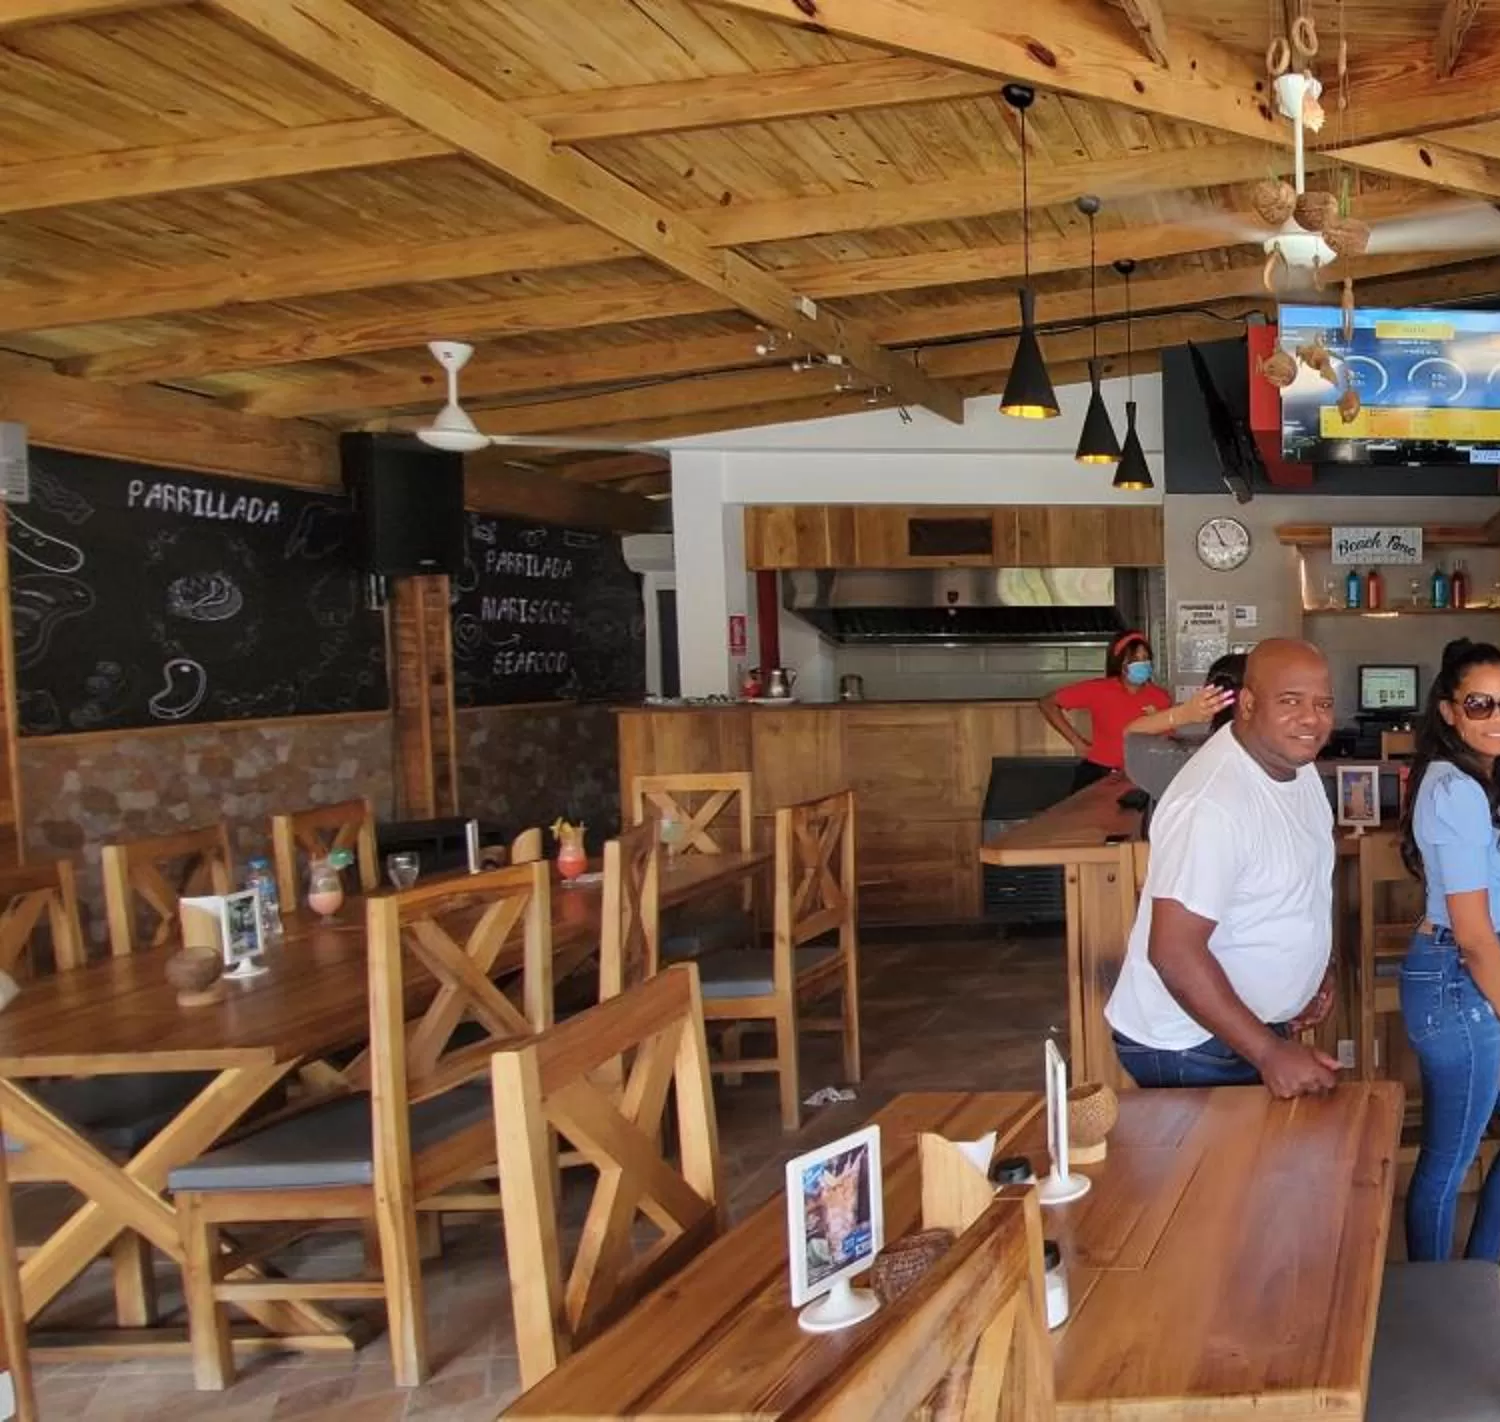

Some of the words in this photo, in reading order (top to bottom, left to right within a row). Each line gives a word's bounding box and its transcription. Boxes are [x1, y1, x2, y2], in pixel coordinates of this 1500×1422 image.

[127, 479, 281, 523] PARRILLADA
[481, 596, 572, 624] MARISCOS
[493, 650, 568, 675] SEAFOOD
